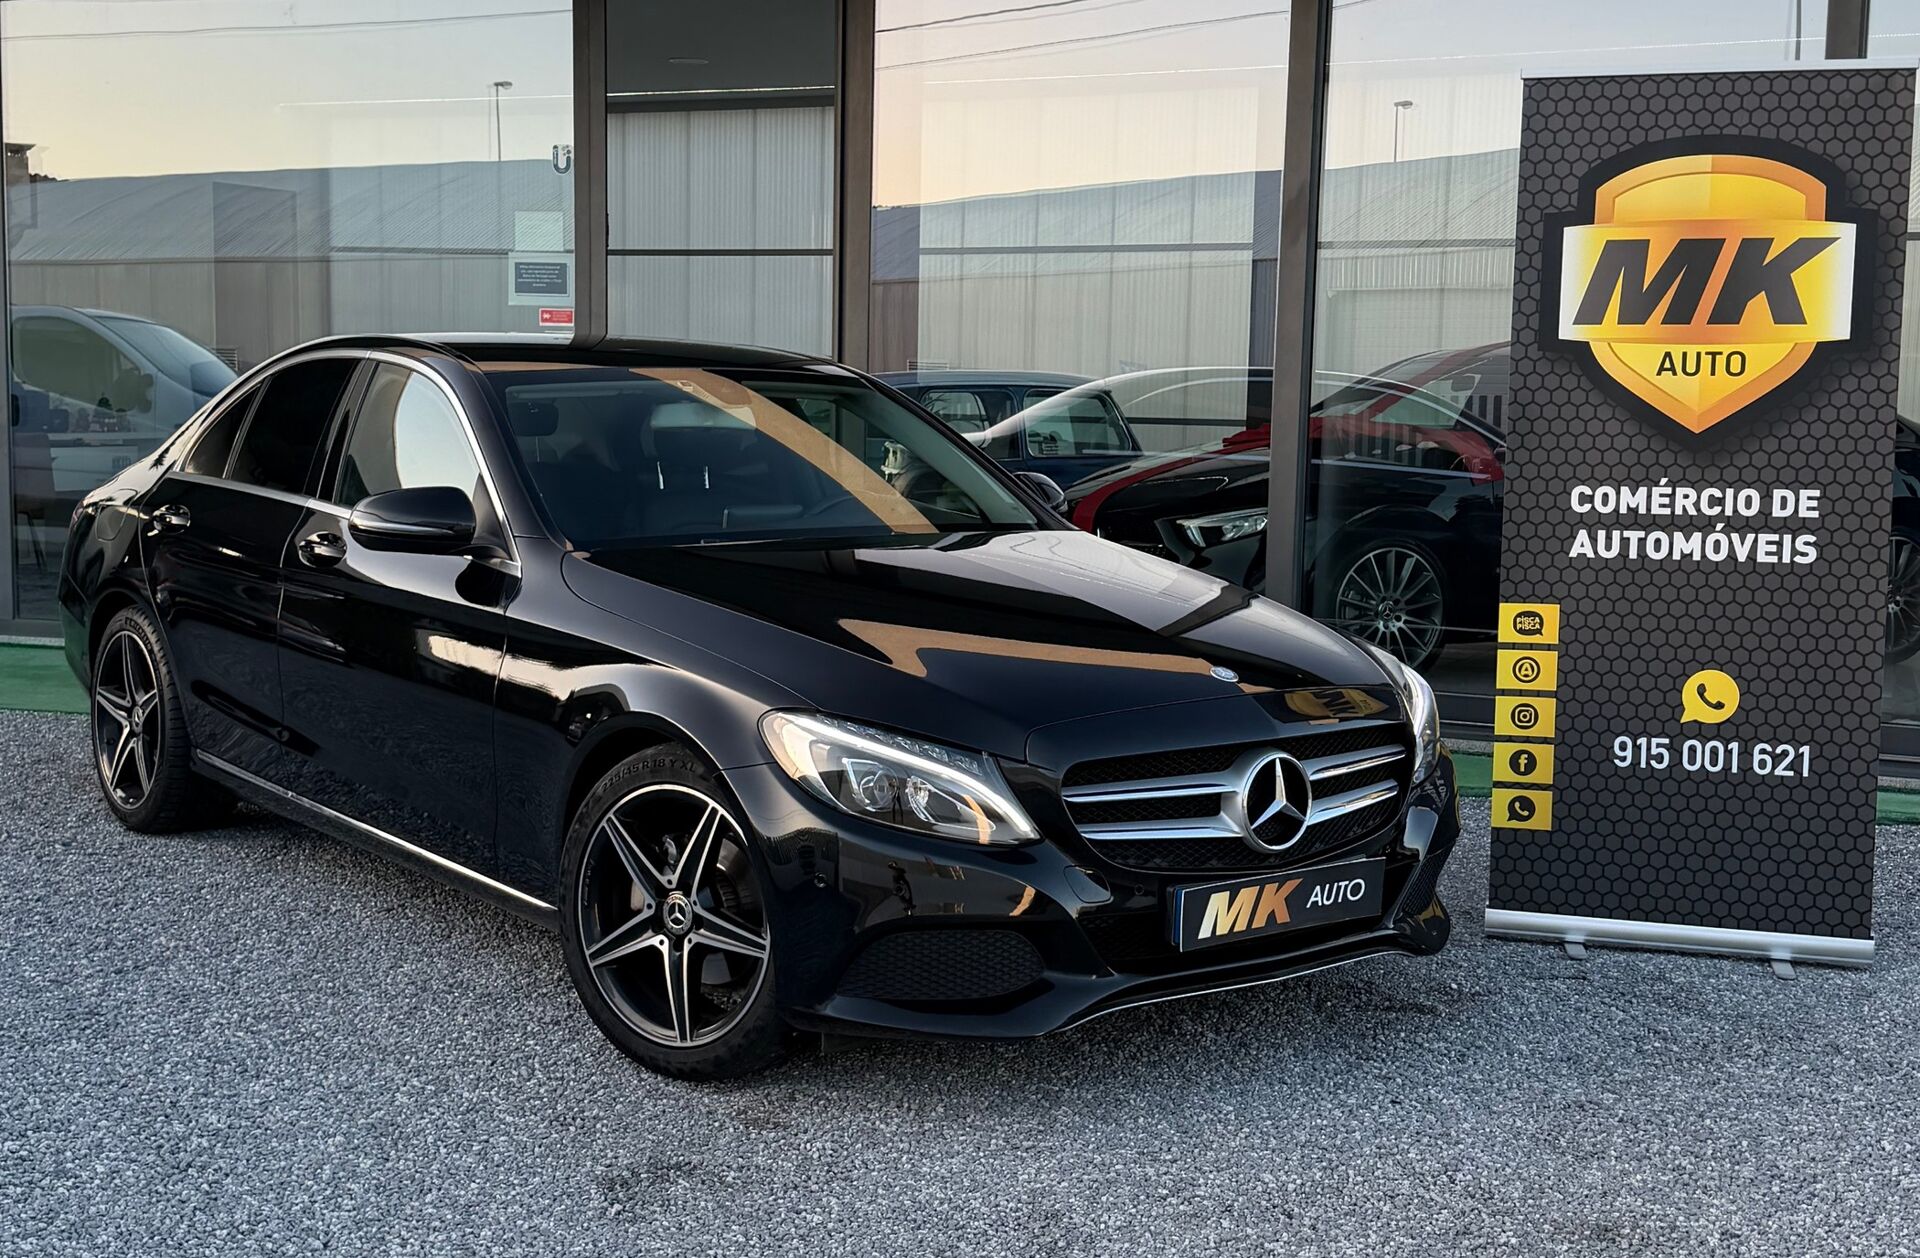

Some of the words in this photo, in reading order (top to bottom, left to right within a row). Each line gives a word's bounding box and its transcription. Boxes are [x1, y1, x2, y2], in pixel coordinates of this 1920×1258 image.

[1572, 237, 1841, 325] MK
[1656, 351, 1746, 376] AUTO
[1570, 477, 1760, 517] COMÉRCIO
[1772, 489, 1820, 518] DE
[1568, 523, 1817, 564] AUTOMÓVEIS
[1613, 735, 1670, 769] 915
[1682, 739, 1739, 773] 001
[1752, 743, 1810, 777] 621
[1198, 878, 1303, 939] MK
[1306, 878, 1366, 908] AUTO
